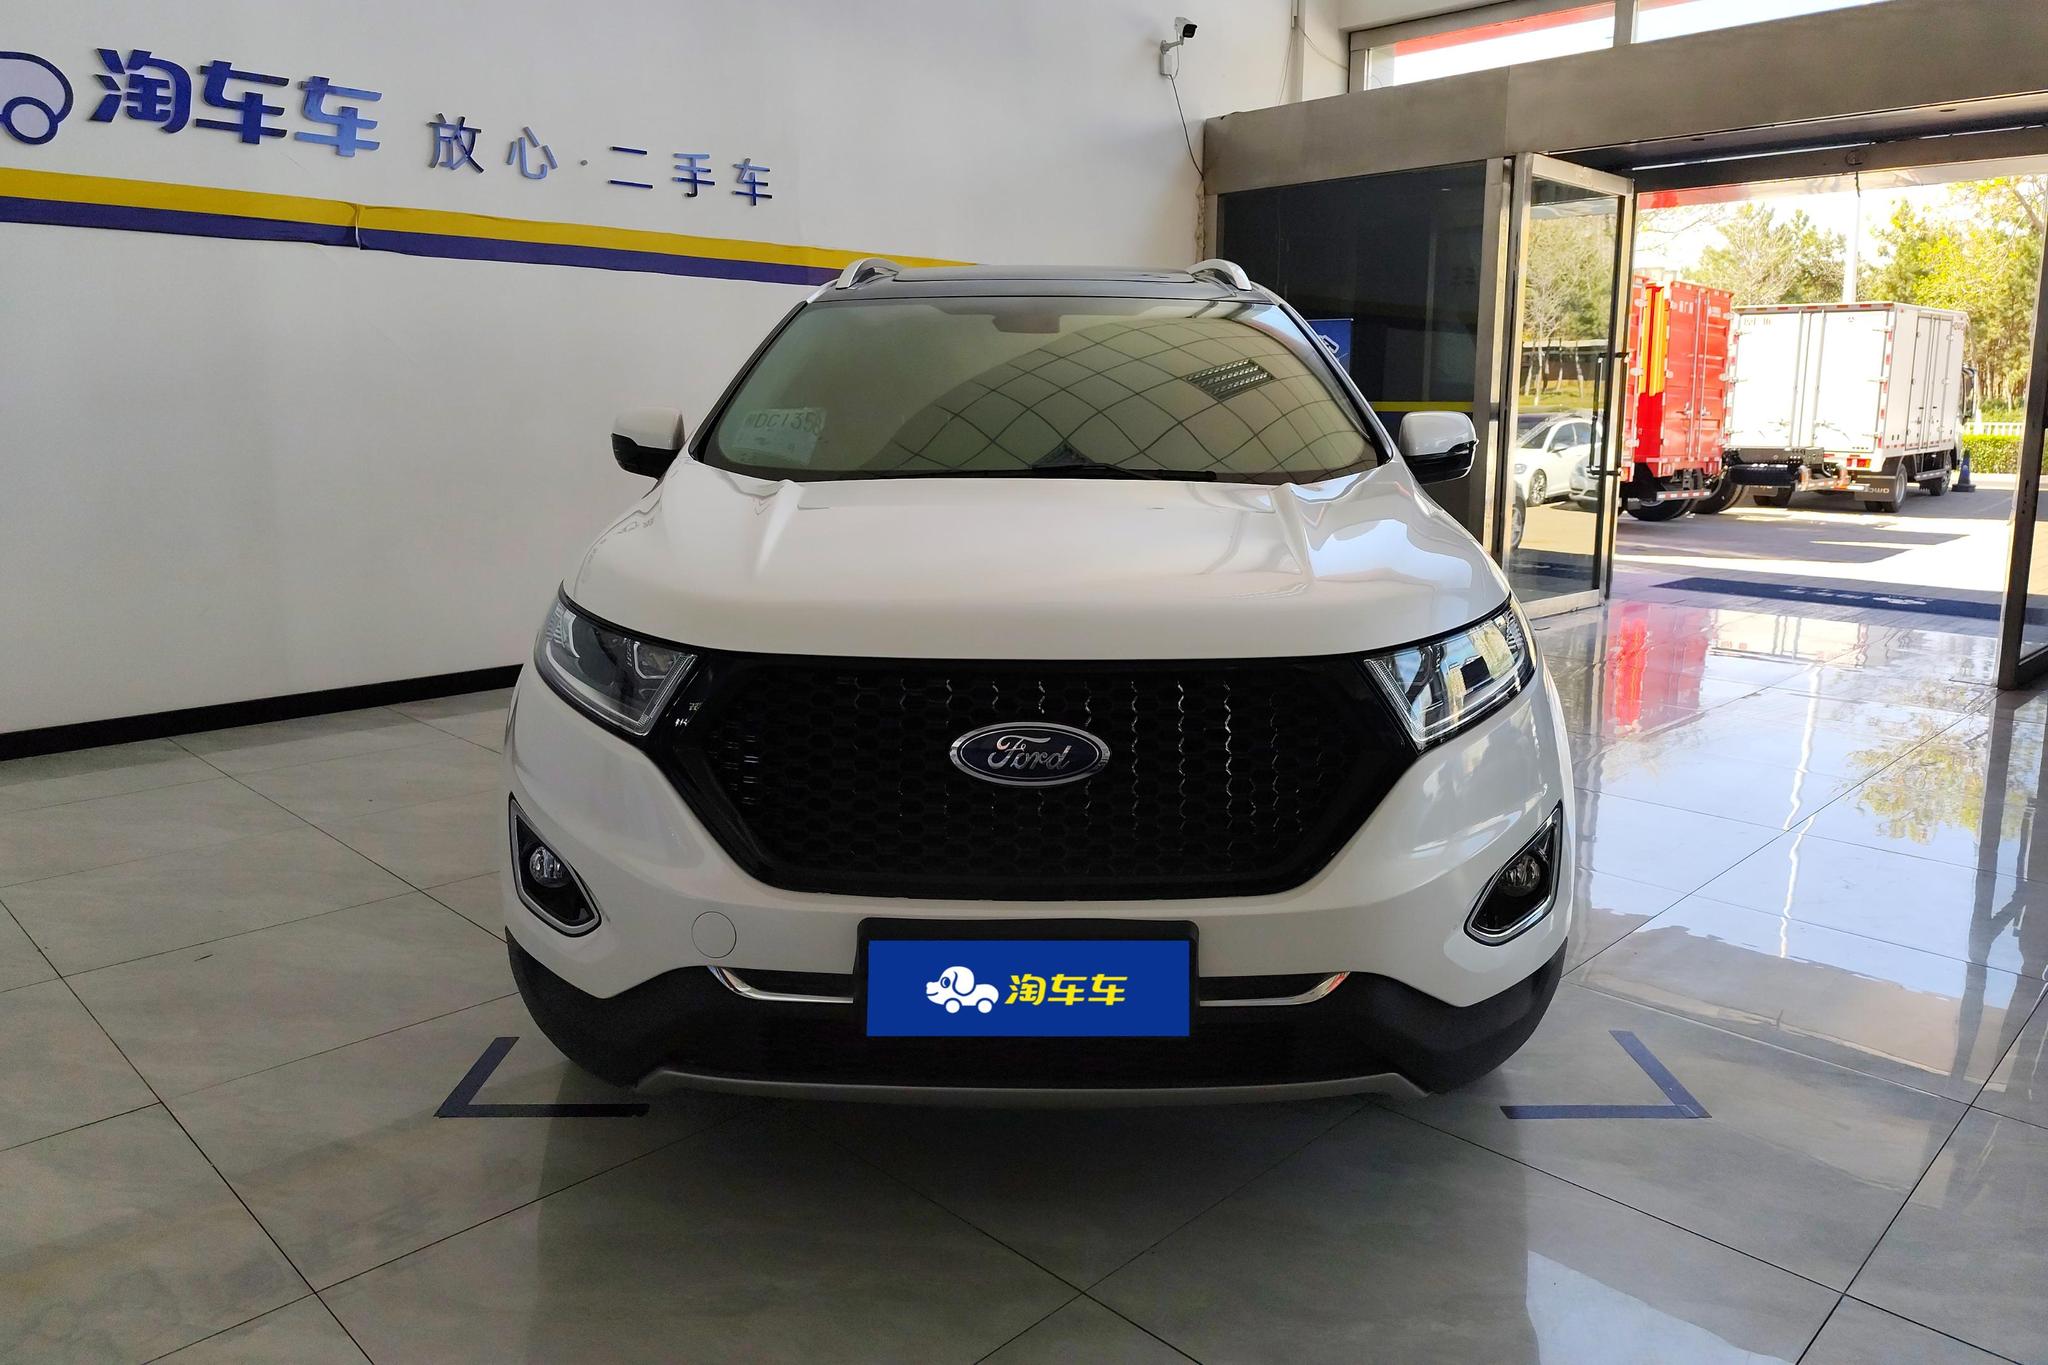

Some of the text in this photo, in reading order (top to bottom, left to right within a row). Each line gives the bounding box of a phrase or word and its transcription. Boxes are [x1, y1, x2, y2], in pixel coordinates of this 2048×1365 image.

[89, 48, 383, 158] 淘车车
[987, 734, 1072, 770] Ford
